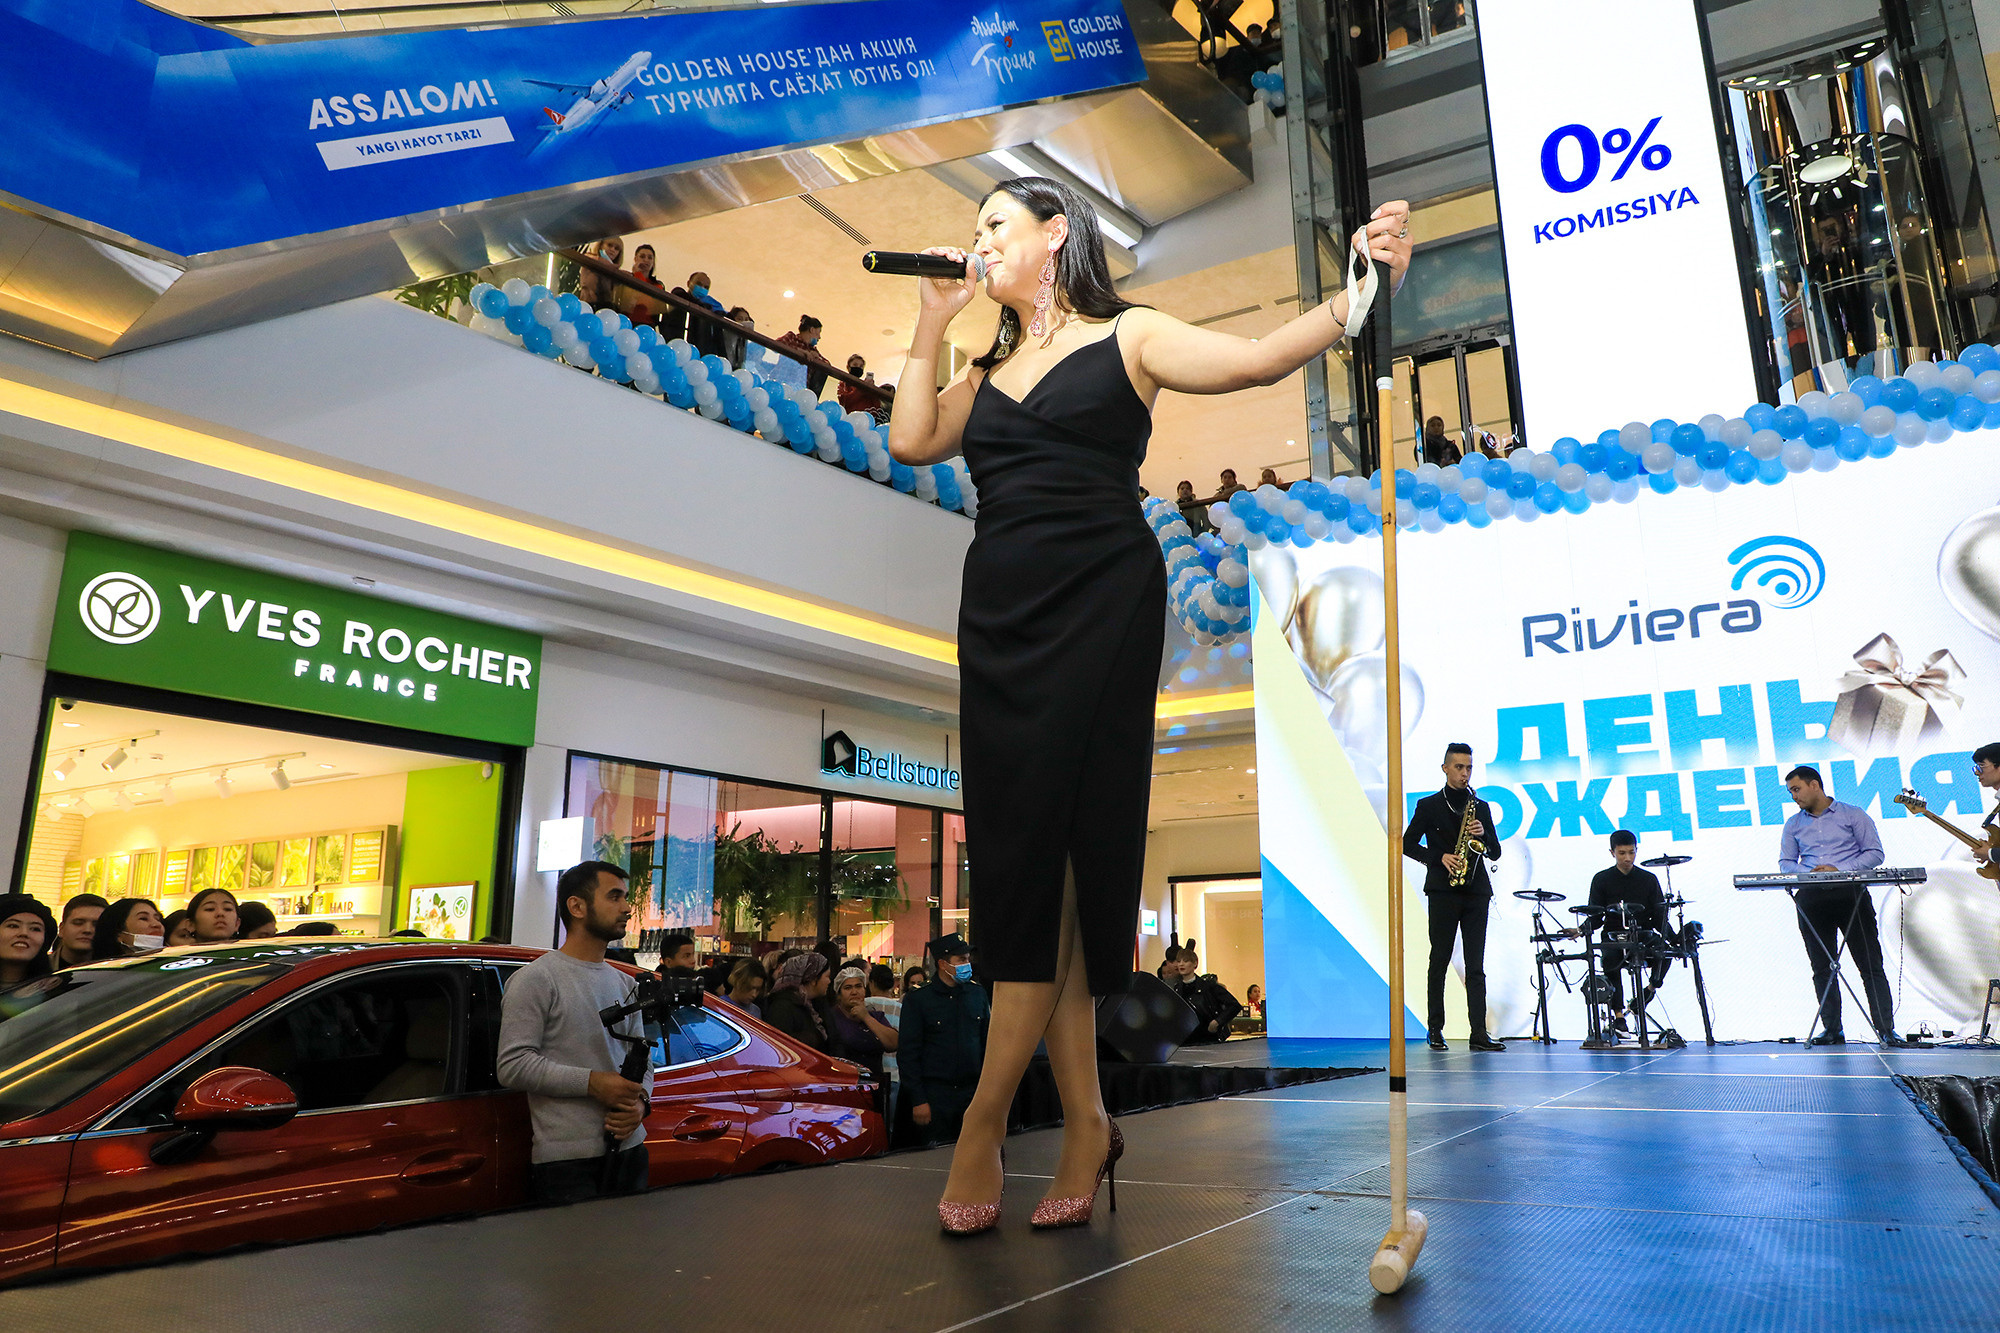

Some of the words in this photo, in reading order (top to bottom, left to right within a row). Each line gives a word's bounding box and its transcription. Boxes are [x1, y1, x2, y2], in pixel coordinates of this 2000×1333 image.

[1068, 15, 1123, 35] GOLDEN
[1076, 38, 1123, 59] HOUSE
[635, 56, 734, 87] GOLDEN
[738, 43, 856, 75] HOUSE'ДАН
[859, 36, 919, 60] АКЦИЯ
[645, 81, 765, 116] ТУРКИЯГА
[848, 62, 903, 87] ЮТИБ
[906, 57, 937, 79] ОЛ!
[308, 78, 499, 130] ASSALOM!
[356, 140, 400, 156] YANGI
[401, 134, 445, 150] HAYOT
[446, 128, 482, 144] TARZI
[1540, 115, 1672, 193] 0%
[1533, 186, 1700, 244] KOMISSIYA
[179, 584, 322, 648] YVES
[343, 619, 533, 690] ROCHER
[1521, 599, 1762, 658] Riviera
[294, 659, 440, 702] FRANCE
[1485, 679, 1842, 784] ДЕНЬ
[855, 746, 960, 791] Bellstore
[1406, 751, 1984, 847] ОЖДЕНИЯ
[329, 901, 354, 914] HAIR
